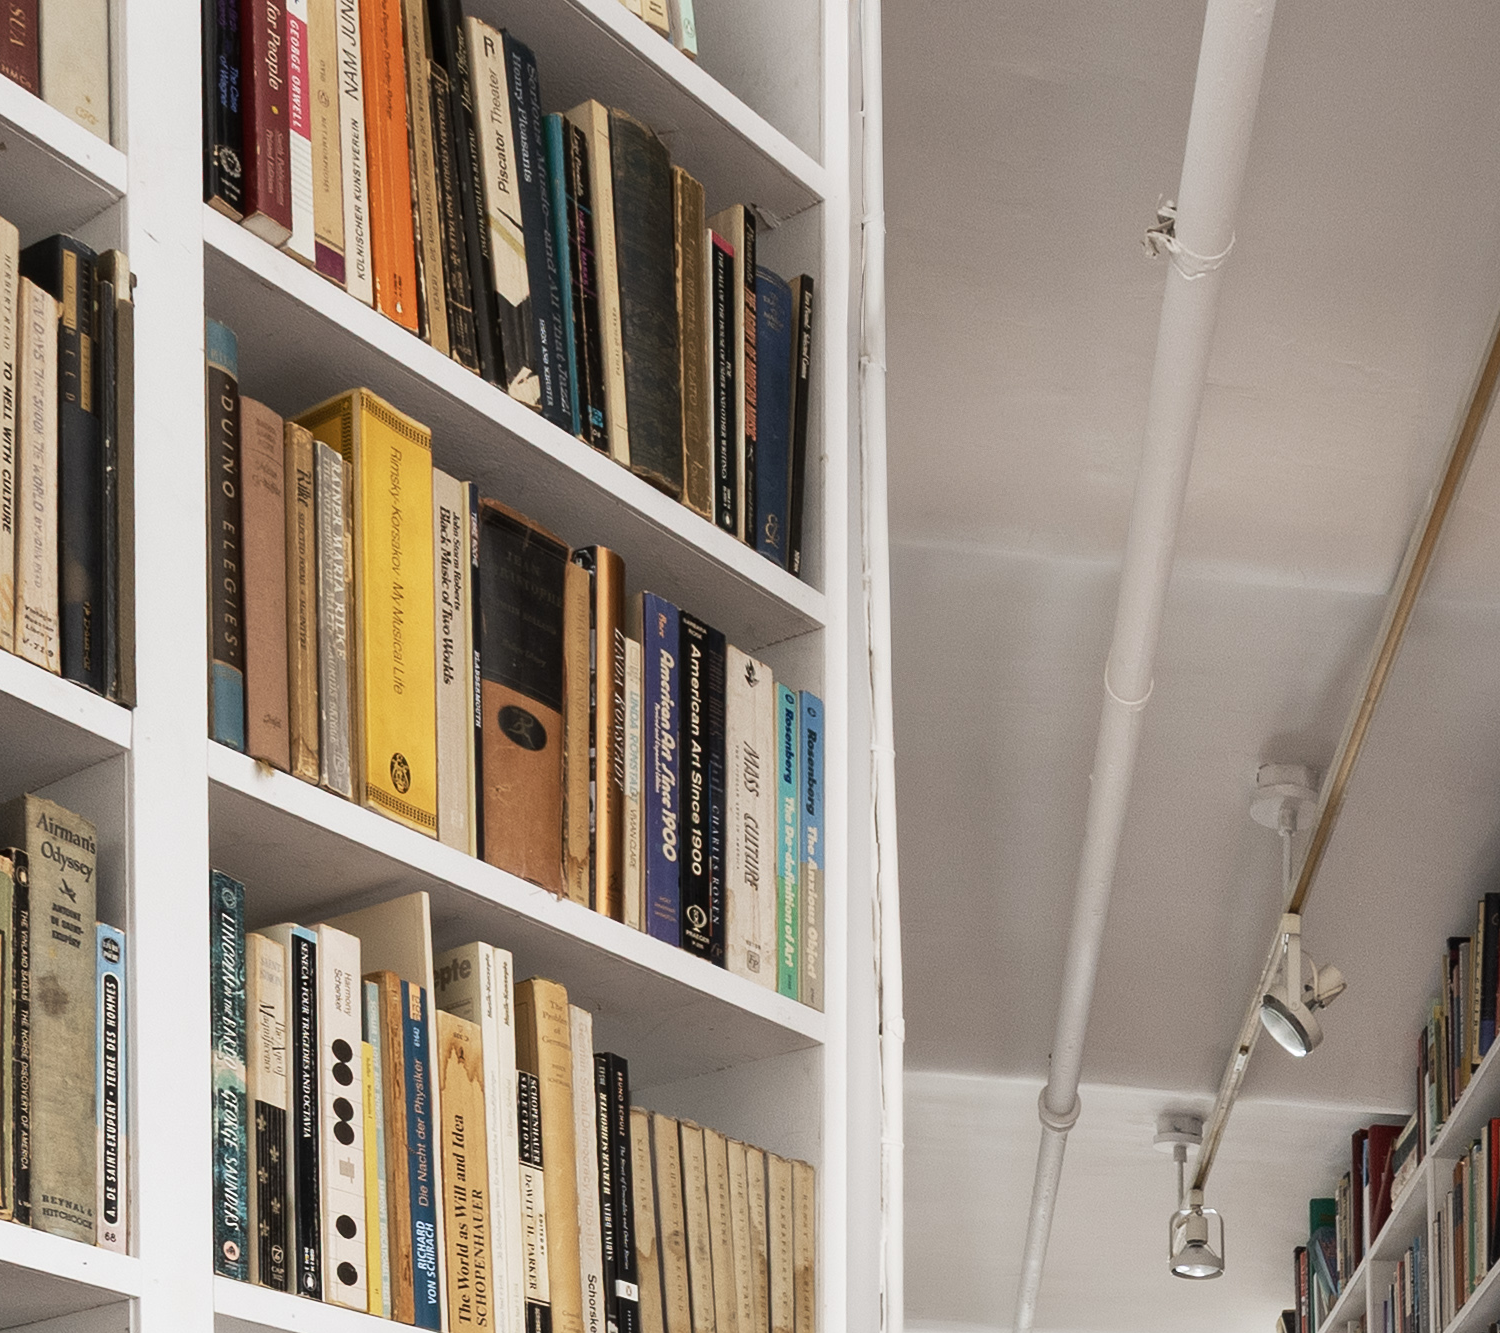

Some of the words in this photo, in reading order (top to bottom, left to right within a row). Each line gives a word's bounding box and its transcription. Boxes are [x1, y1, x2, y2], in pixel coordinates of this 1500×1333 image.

[288, 19, 301, 70] GEORGE
[290, 74, 304, 130] ORWELL
[491, 68, 505, 122] Theater
[498, 128, 512, 192] Piscator
[220, 400, 235, 499] DUINO
[222, 520, 236, 648] ELEGIES
[35, 809, 97, 857] Airman's
[40, 841, 95, 883] Odyssey
[104, 1230, 117, 1243] 68
[474, 1189, 488, 1326] SCHOPENHAUER
